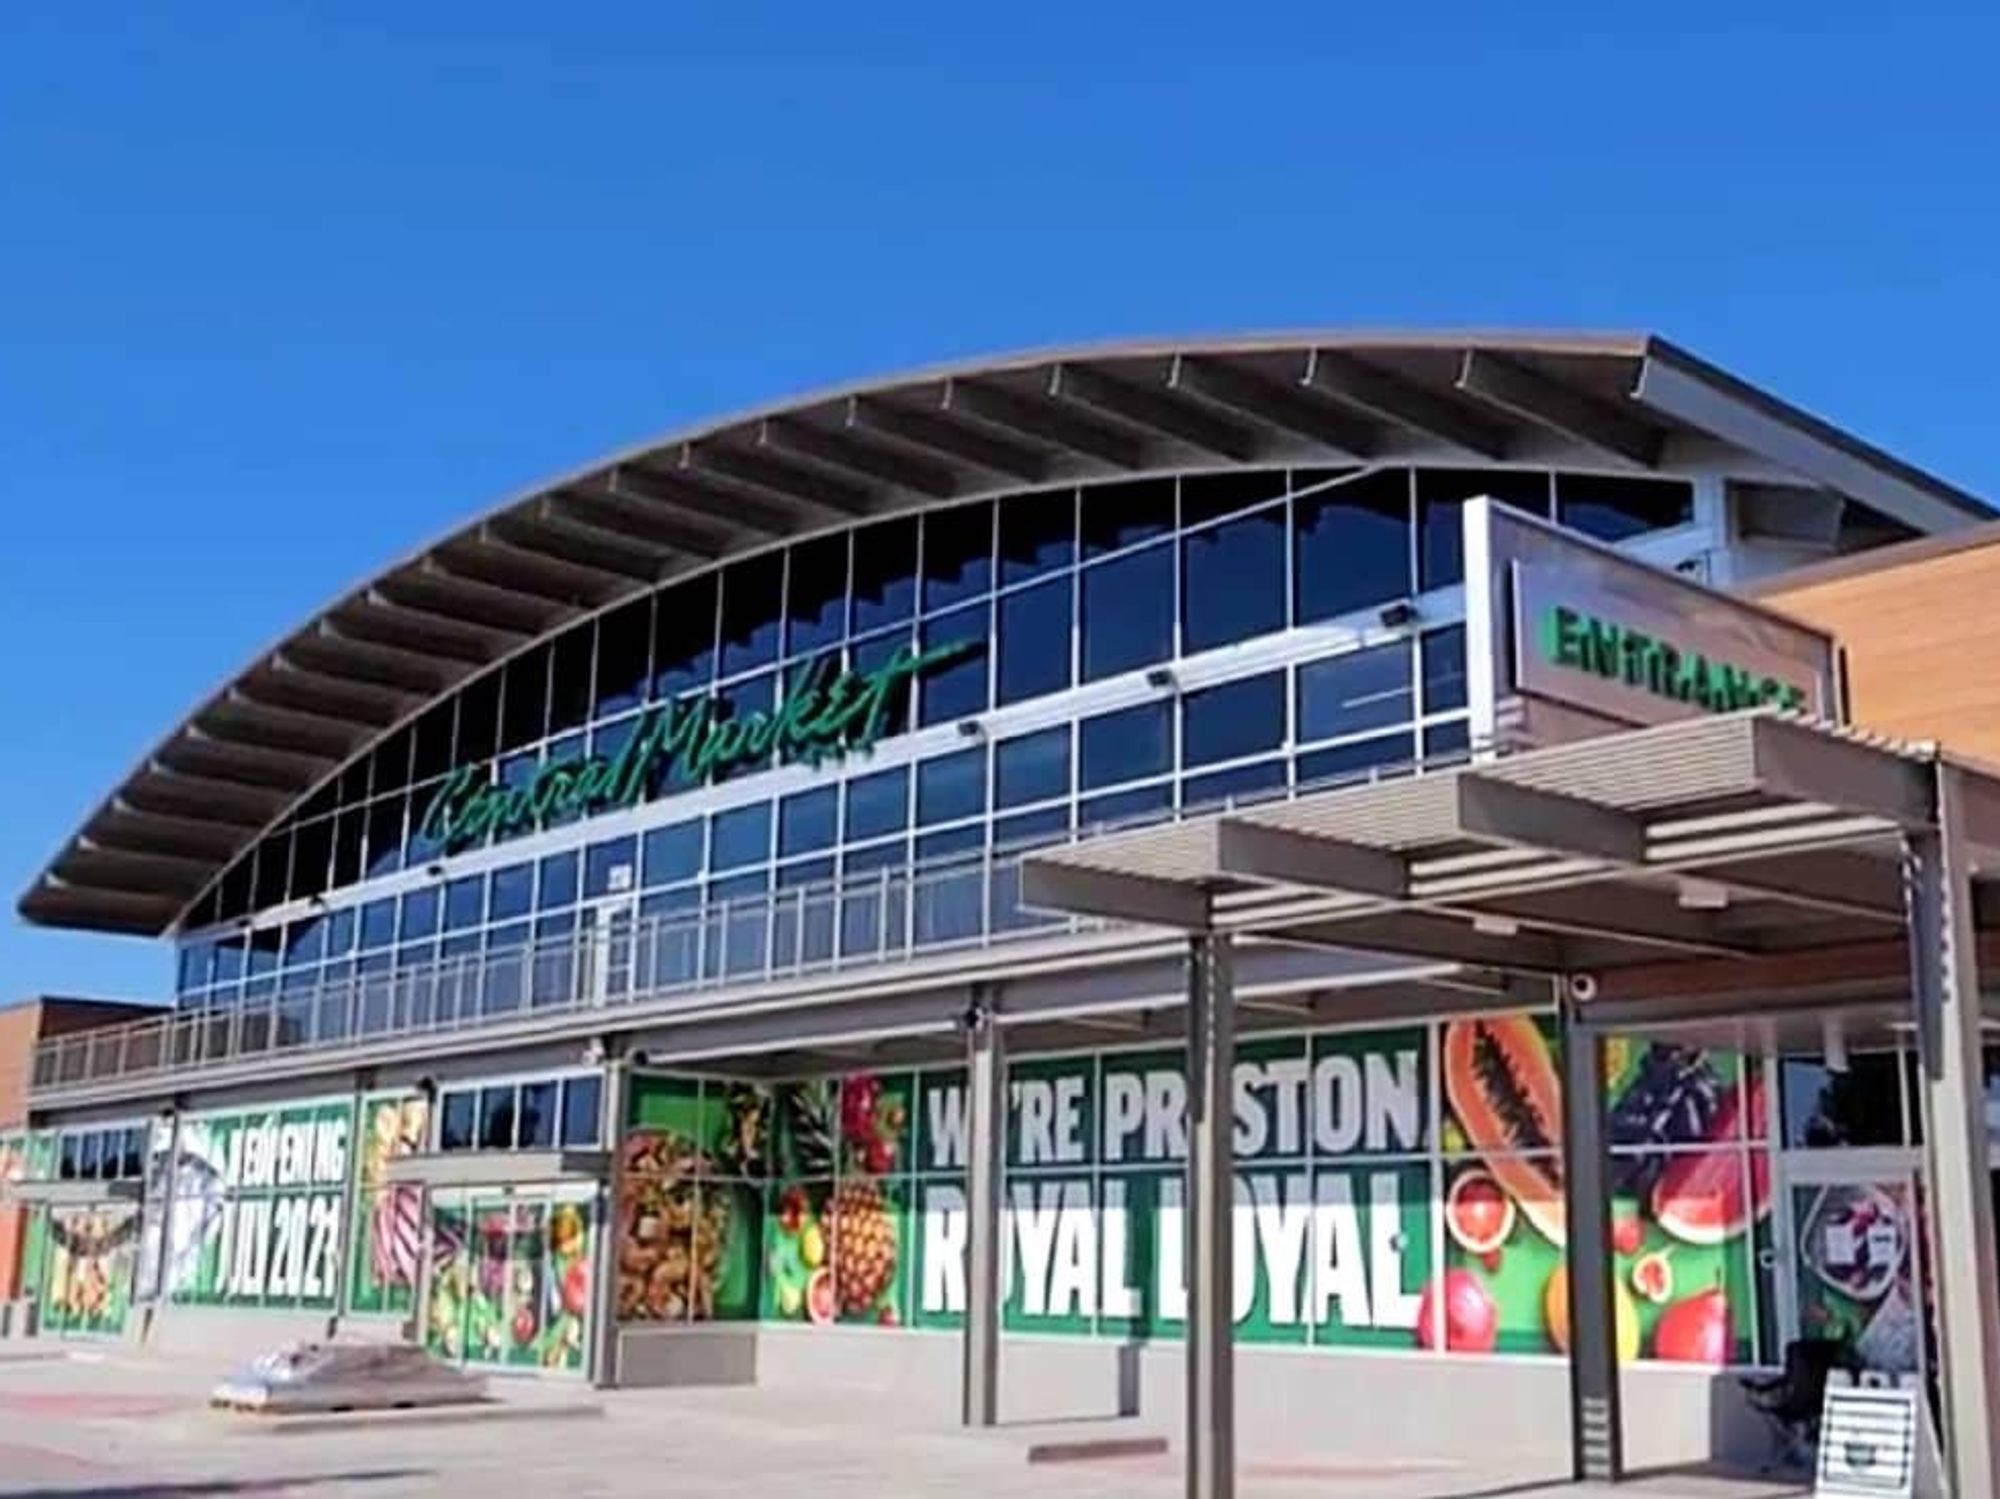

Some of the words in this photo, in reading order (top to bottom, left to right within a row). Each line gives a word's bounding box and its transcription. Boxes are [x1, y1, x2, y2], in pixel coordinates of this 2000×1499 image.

[420, 714, 645, 846] Central
[625, 643, 982, 798] Market
[928, 1074, 1087, 1168] W'RE
[1105, 1050, 1420, 1161] PRSTON
[922, 1179, 1141, 1318] RYAL
